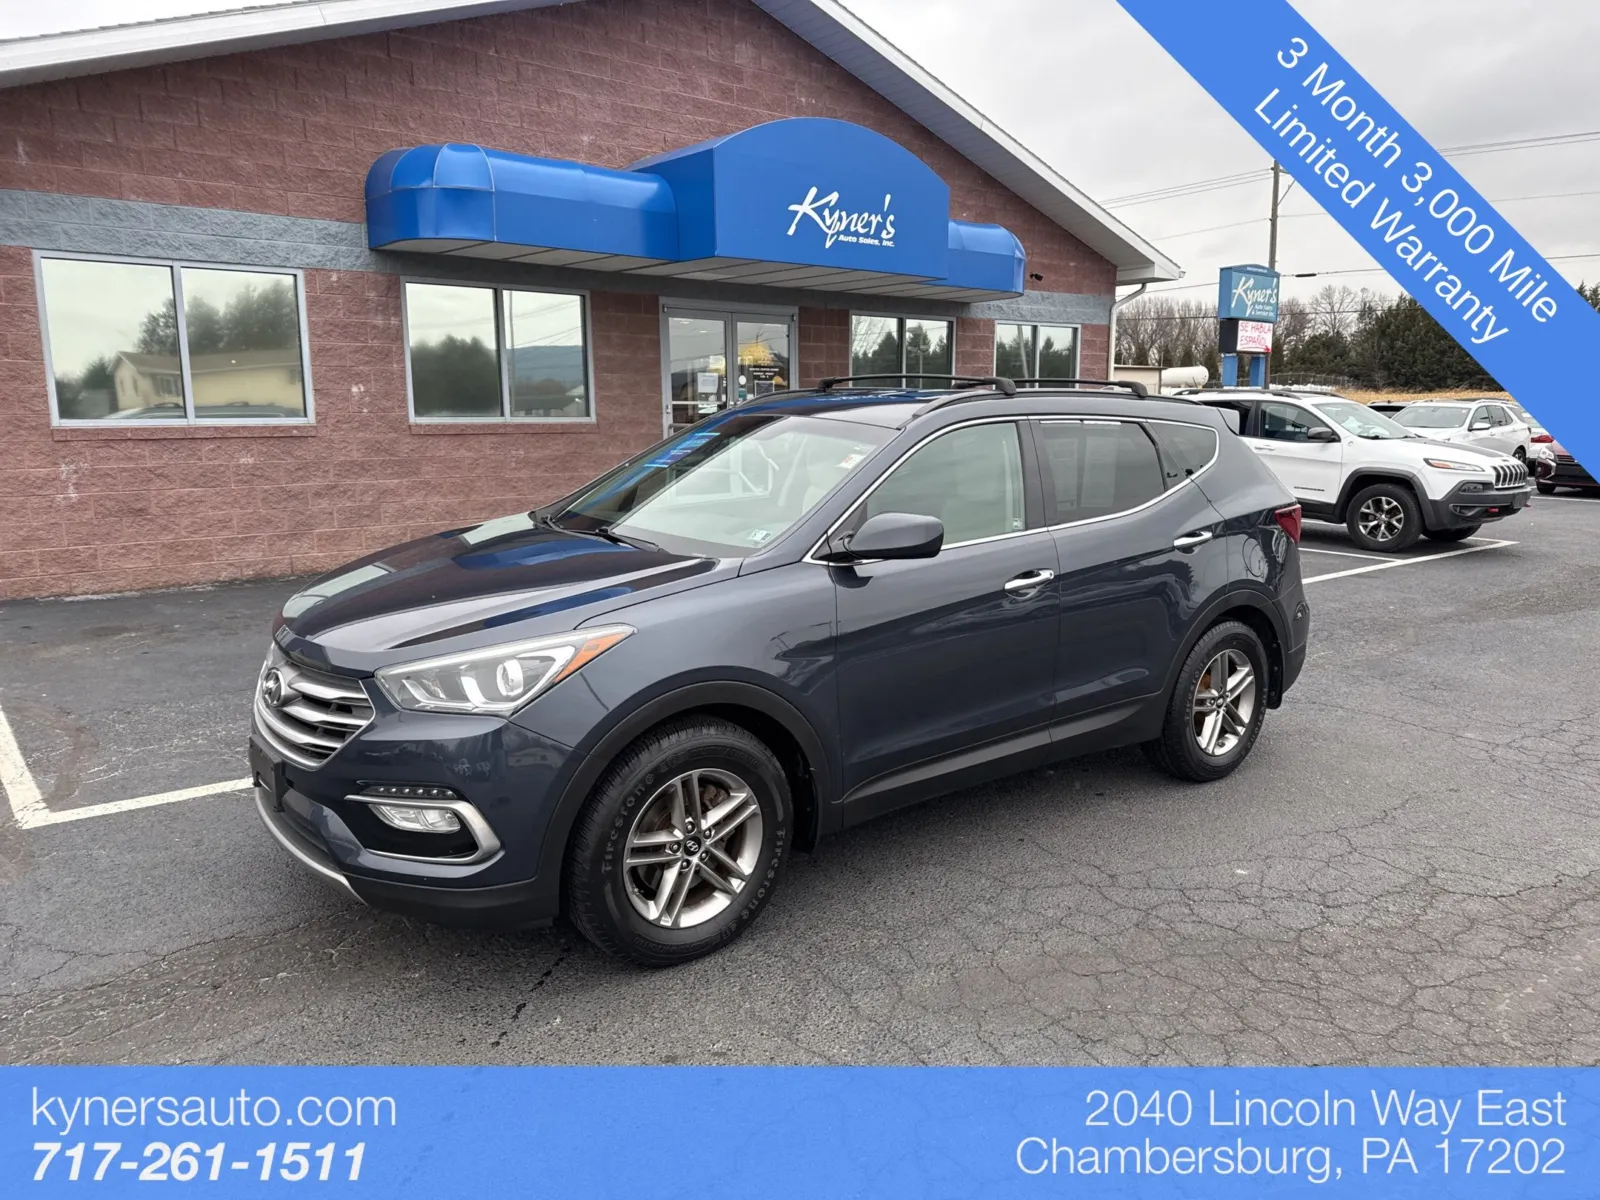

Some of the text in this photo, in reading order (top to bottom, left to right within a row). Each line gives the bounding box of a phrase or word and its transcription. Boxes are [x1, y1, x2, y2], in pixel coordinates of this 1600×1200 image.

[787, 186, 895, 249] Kyner's
[838, 234, 857, 243] Auto
[1231, 276, 1277, 317] Kyner's
[1240, 322, 1272, 334] SE HABLA
